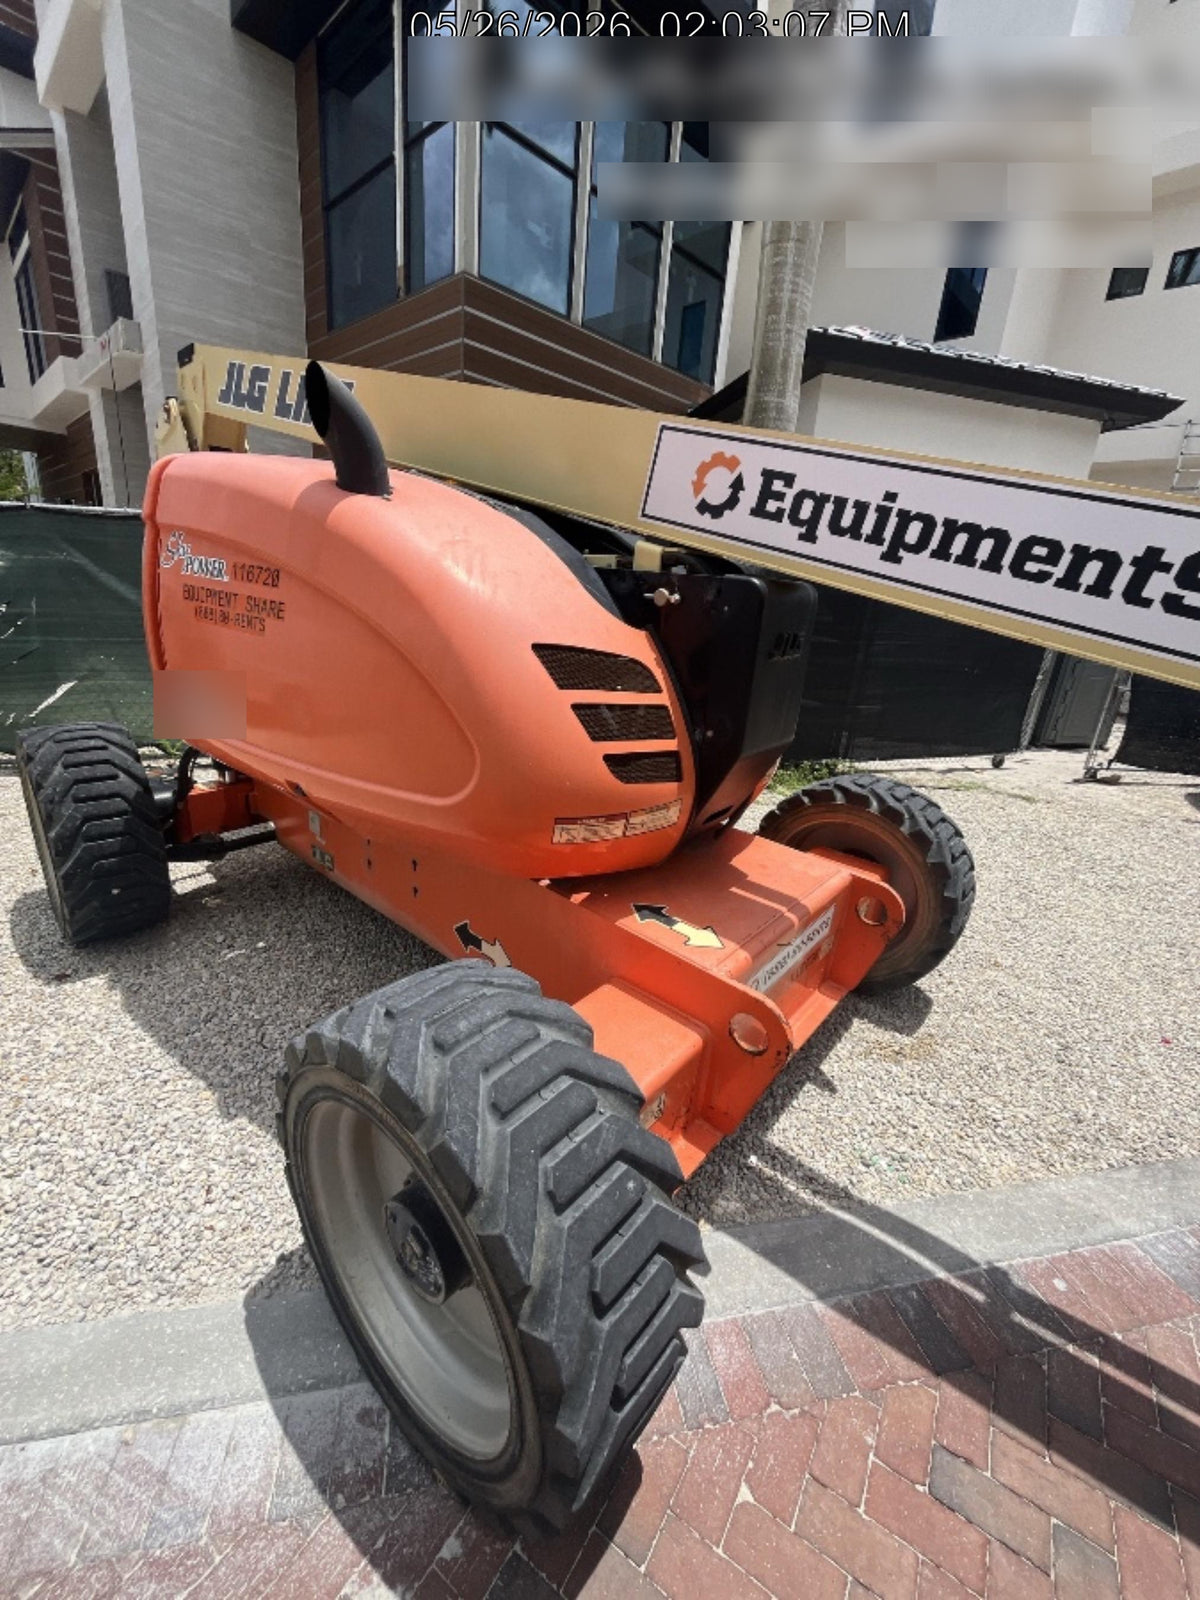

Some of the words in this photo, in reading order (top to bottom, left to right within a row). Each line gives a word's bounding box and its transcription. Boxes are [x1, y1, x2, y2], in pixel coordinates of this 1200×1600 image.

[218, 361, 271, 413] JLG
[273, 369, 355, 427] LI
[245, 595, 286, 621] SHARE
